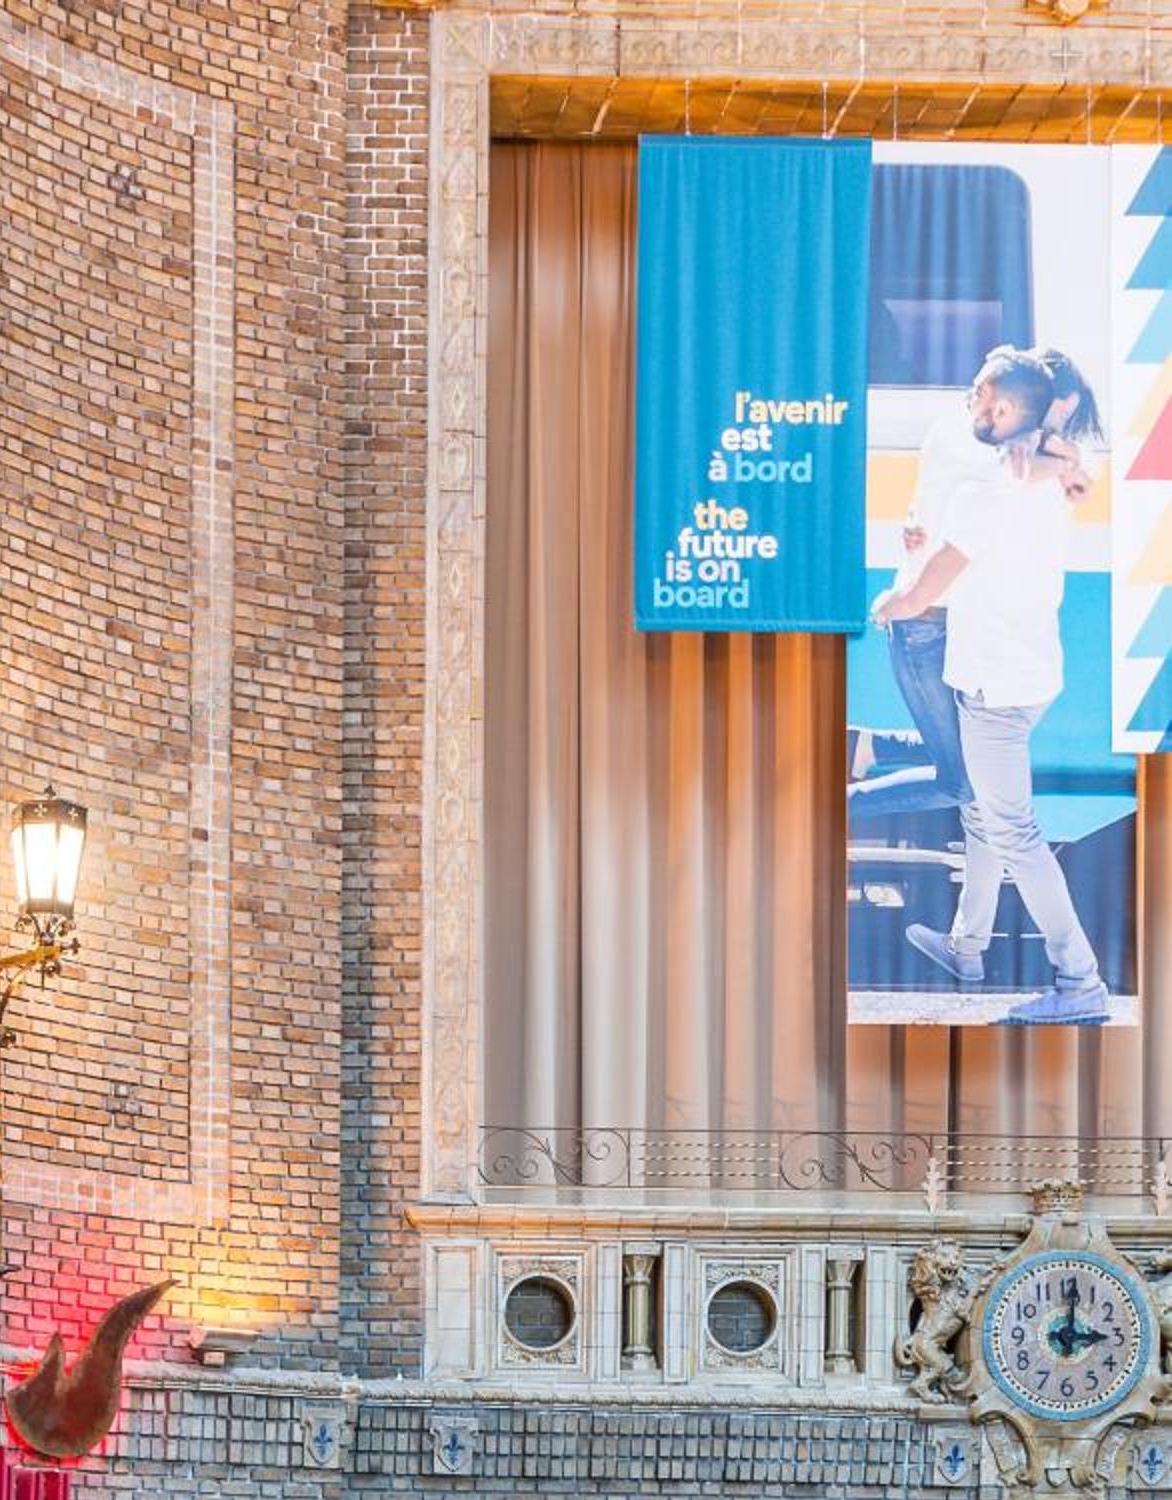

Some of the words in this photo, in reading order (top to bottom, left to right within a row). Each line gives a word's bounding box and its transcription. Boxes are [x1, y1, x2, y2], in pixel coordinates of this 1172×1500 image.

[734, 391, 848, 425] l'avenir
[721, 424, 772, 452] est
[708, 451, 727, 482] à
[734, 453, 813, 483] bord
[694, 500, 748, 531] the
[678, 528, 778, 559] future
[665, 551, 692, 582] is
[698, 559, 741, 582] on
[653, 577, 749, 609] board
[1016, 1301, 1036, 1321] 10
[1101, 1301, 1114, 1323] 2
[1011, 1326, 1025, 1346] 9
[1112, 1327, 1125, 1347] 3
[1016, 1351, 1030, 1371] 8
[1102, 1354, 1117, 1372] 4
[1036, 1370, 1050, 1390] 7
[1060, 1376, 1074, 1397] 6
[1085, 1370, 1099, 1391] 5
